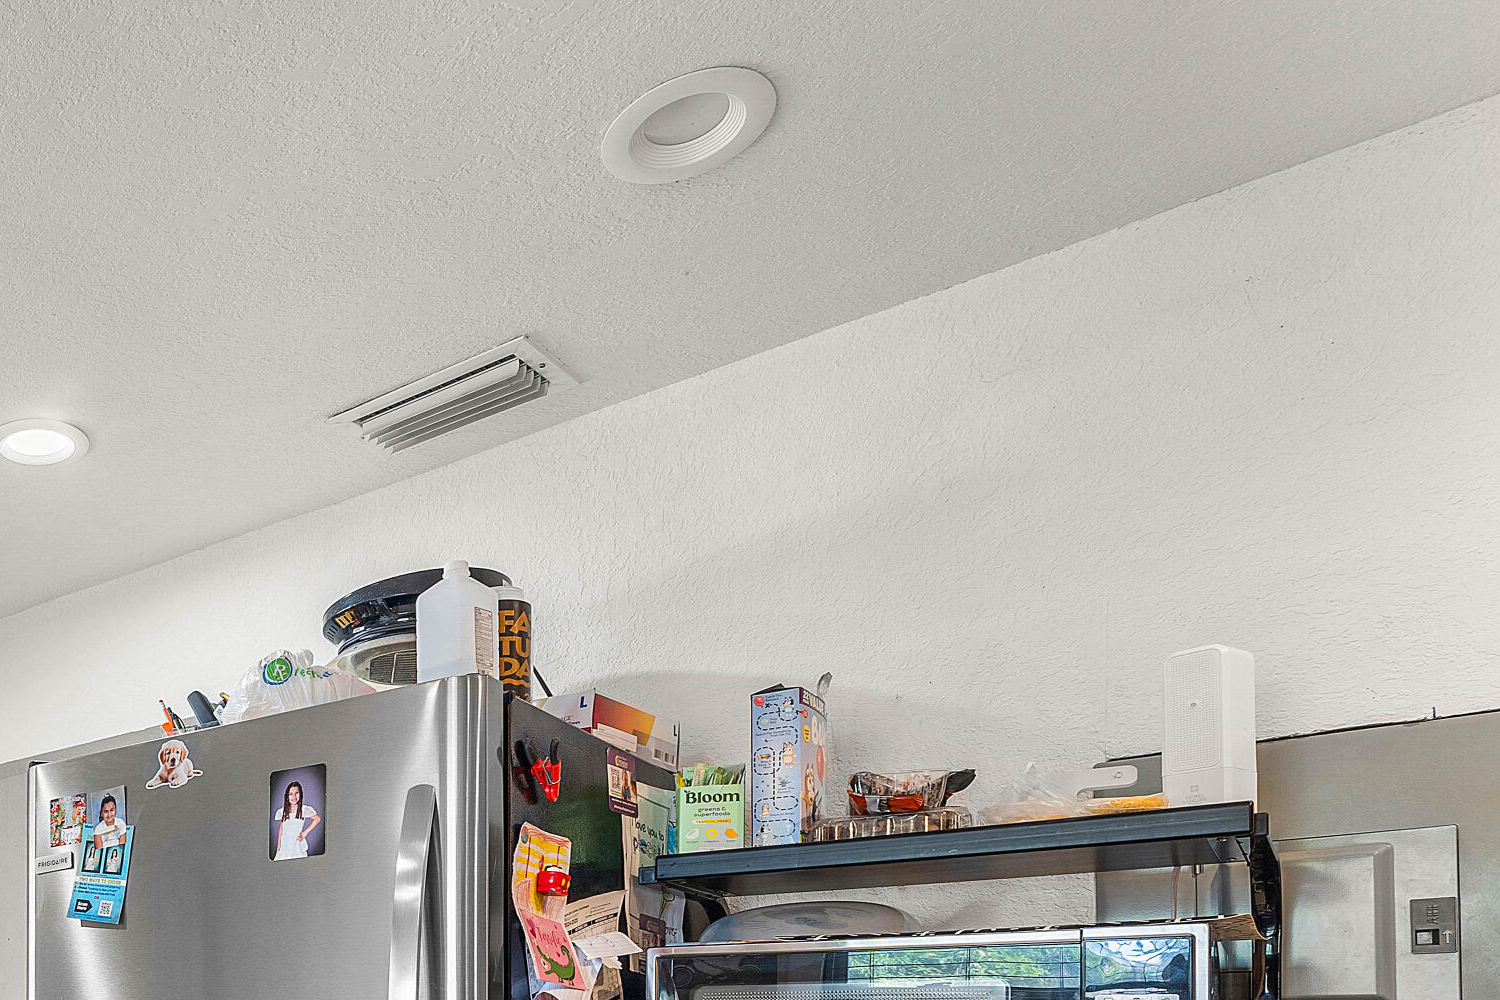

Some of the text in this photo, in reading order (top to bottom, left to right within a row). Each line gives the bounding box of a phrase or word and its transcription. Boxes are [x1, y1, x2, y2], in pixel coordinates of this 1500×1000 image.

[498, 609, 531, 636] FA
[499, 635, 530, 658] TU
[499, 657, 531, 678] DA
[580, 696, 587, 708] L
[684, 790, 740, 804] Bloom
[37, 857, 68, 868] FRIGIDAIRE
